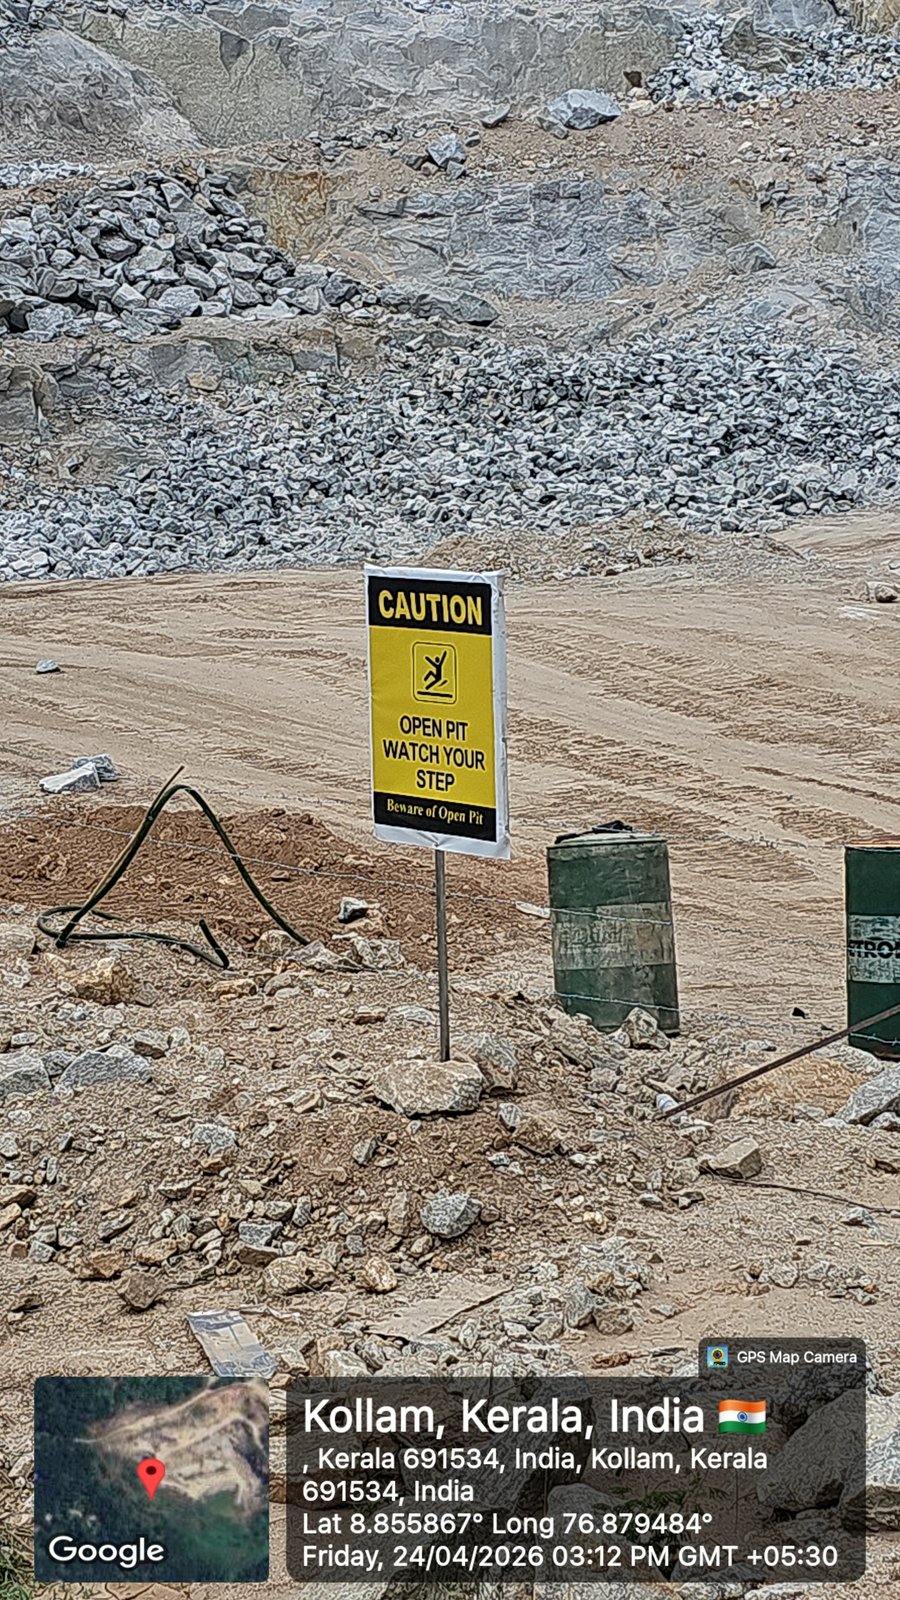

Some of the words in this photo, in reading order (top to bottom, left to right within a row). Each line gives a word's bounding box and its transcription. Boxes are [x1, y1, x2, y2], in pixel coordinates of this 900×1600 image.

[378, 589, 483, 626] CAUTION
[400, 715, 442, 738] OPEN
[446, 720, 468, 741] PIT
[383, 739, 440, 765] WATCH
[443, 746, 486, 771] YOUR
[416, 769, 455, 792] STEP
[387, 798, 423, 817] Beware
[425, 804, 438, 819] of
[438, 807, 466, 825] Open
[469, 810, 483, 825] Pit
